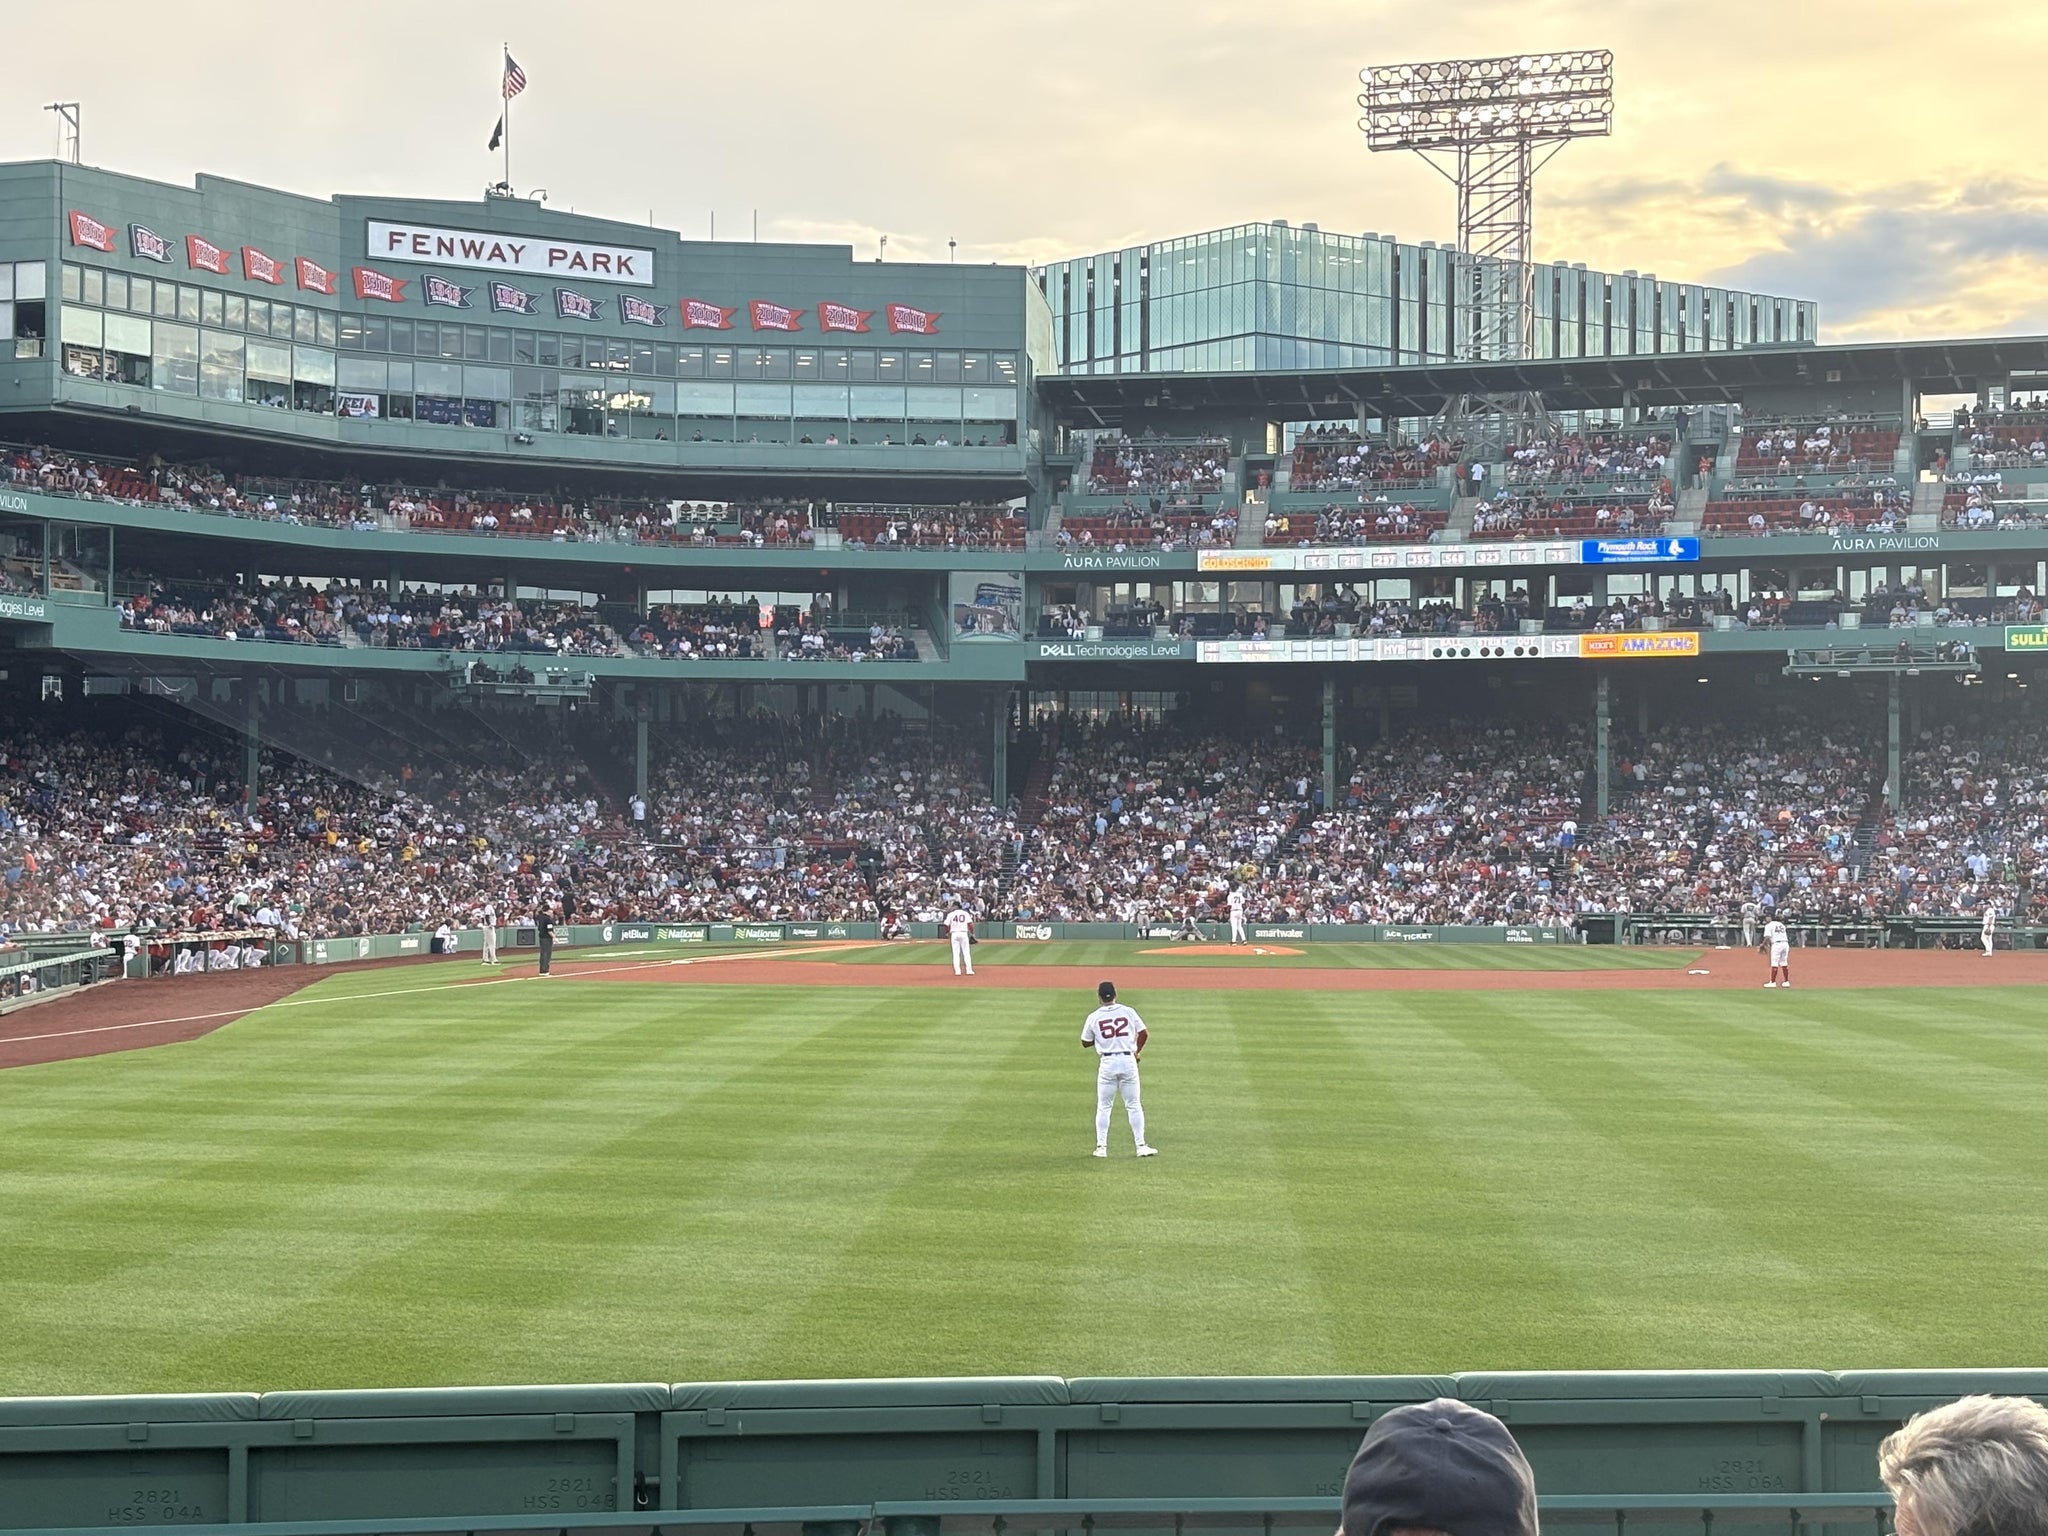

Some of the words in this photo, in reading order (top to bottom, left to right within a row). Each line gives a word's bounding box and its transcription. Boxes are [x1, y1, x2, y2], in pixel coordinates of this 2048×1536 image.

[389, 231, 526, 264] FENWAY
[549, 248, 635, 276] PARK
[362, 275, 393, 294] 1918
[429, 282, 461, 302] 1946
[496, 288, 528, 308] 1967
[562, 295, 592, 314] 1975
[625, 301, 656, 320] 1986
[687, 306, 722, 324] 2004
[756, 306, 791, 324] 2007
[826, 309, 859, 327] 2013
[894, 310, 926, 328] 2018
[1598, 541, 1635, 552] Plymouth
[1636, 541, 1658, 551] Rock
[1879, 537, 1939, 549] PAVILION
[1106, 556, 1160, 567] PAVILION
[1202, 557, 1272, 568] GOLDSCHMIDT
[24, 602, 44, 617] Level
[1439, 638, 1463, 646] BALL
[1477, 638, 1507, 646] STRIKE
[1517, 637, 1534, 645] OUT
[1622, 637, 1693, 652] AMAZING
[1040, 644, 1075, 656] DELL
[1075, 644, 1148, 659] Technologies
[1151, 644, 1180, 656] Level
[1234, 896, 1241, 904] 71
[953, 914, 965, 923] 40
[621, 928, 649, 941] jetBlue
[668, 929, 704, 939] National
[746, 928, 781, 939] National
[1255, 928, 1304, 938] smartwater
[1403, 932, 1433, 941] TICKET
[1098, 1017, 1129, 1039] 52
[548, 1478, 593, 1493] 2821
[1699, 1476, 1735, 1490] HSS
[1748, 1476, 1784, 1489] 06A
[133, 1490, 181, 1504] 2821
[925, 1488, 961, 1501] HSS
[976, 1487, 1013, 1500] 05A
[524, 1495, 561, 1509] HSS
[108, 1506, 146, 1520] HSS
[163, 1506, 203, 1519] 04A
